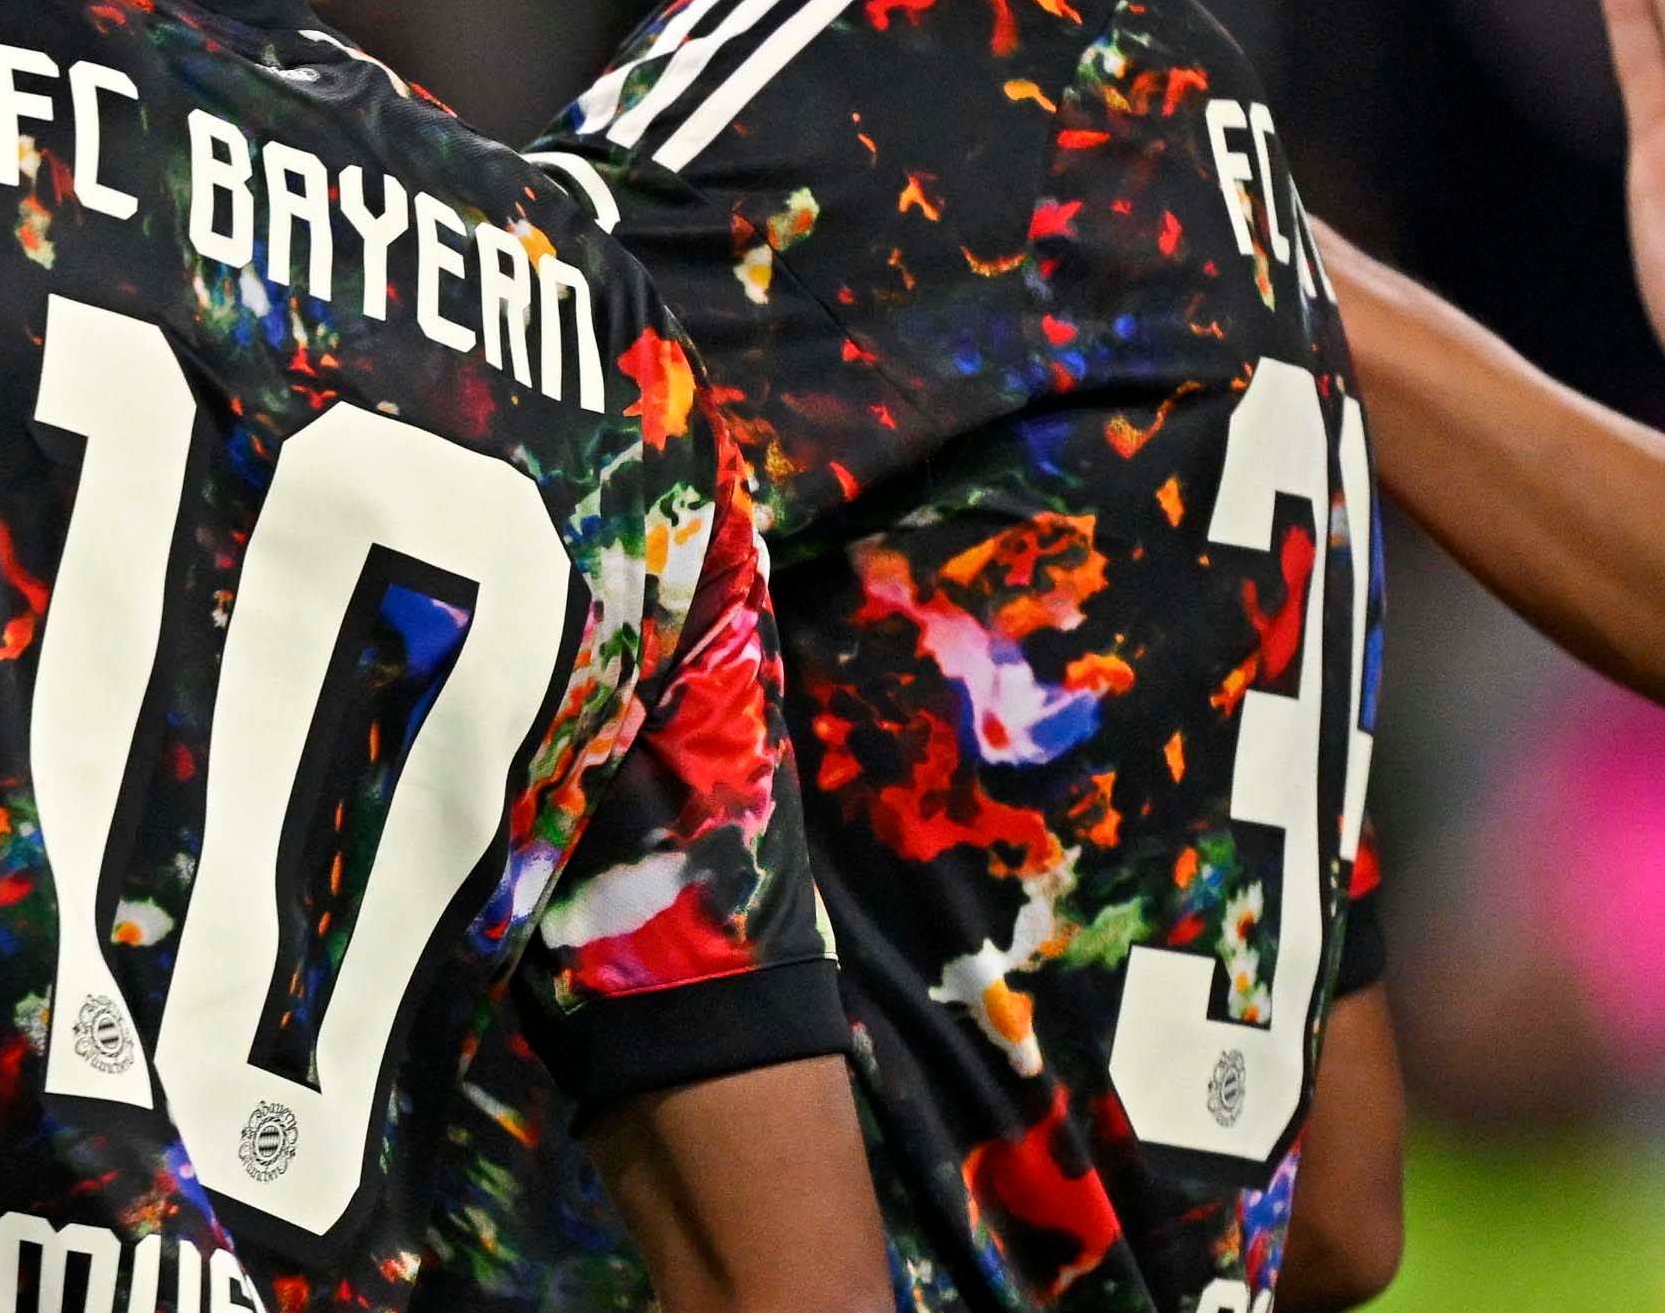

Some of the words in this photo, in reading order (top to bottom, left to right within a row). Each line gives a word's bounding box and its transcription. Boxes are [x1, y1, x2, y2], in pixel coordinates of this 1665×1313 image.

[188, 109, 605, 413] BAYERN
[1206, 99, 1290, 265] FC
[30, 293, 570, 1236] 10
